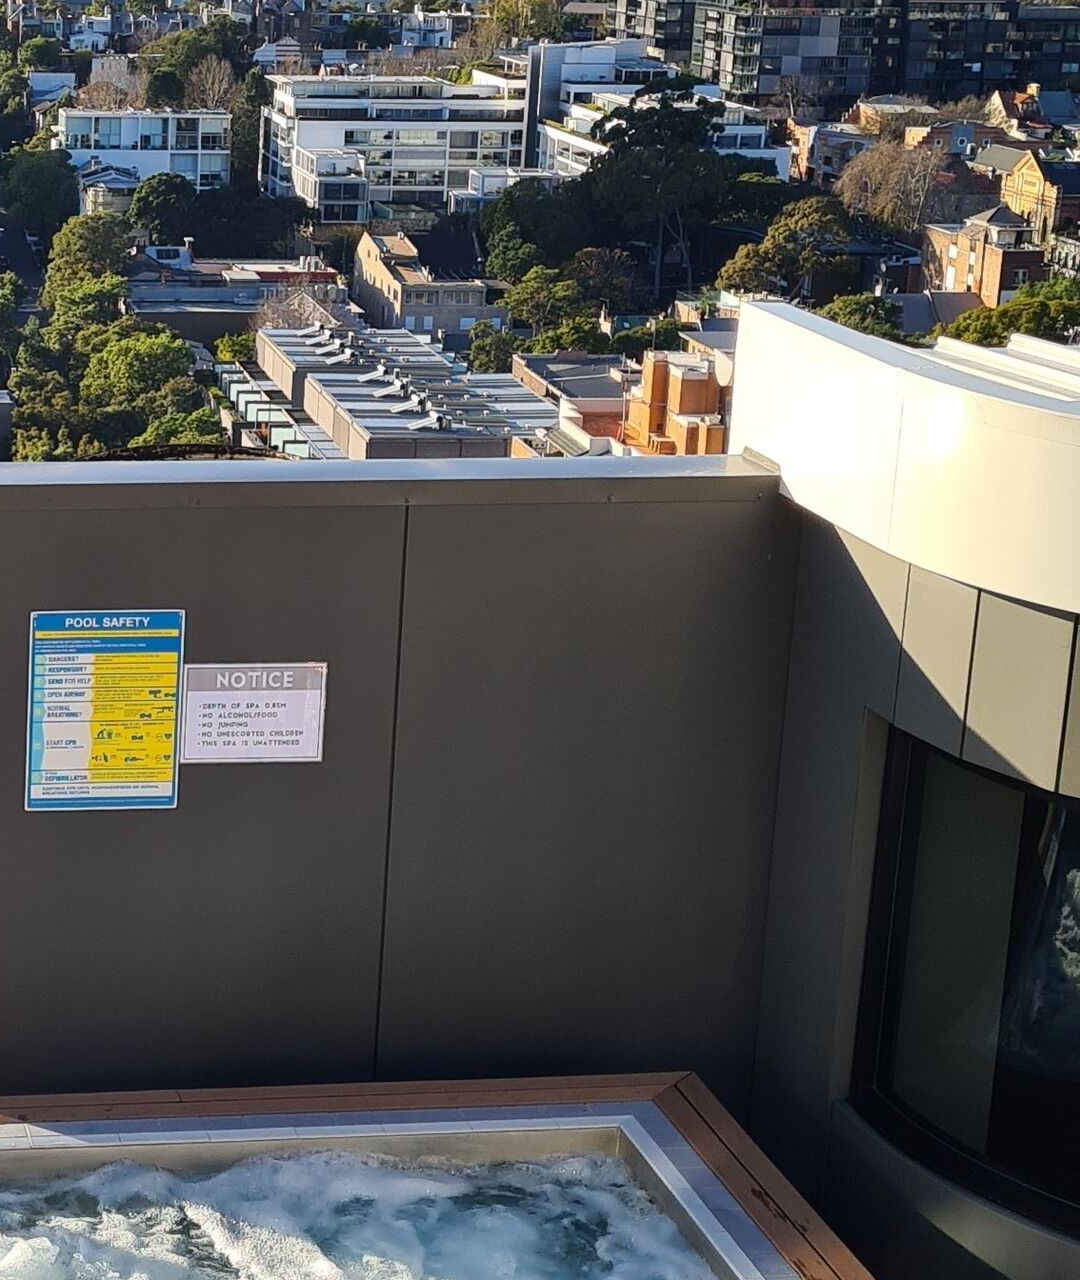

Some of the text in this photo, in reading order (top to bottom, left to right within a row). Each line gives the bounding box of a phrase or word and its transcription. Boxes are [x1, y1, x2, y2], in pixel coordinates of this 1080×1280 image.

[65, 616, 151, 628] POOL SAFETY
[216, 671, 294, 688] NOTICE
